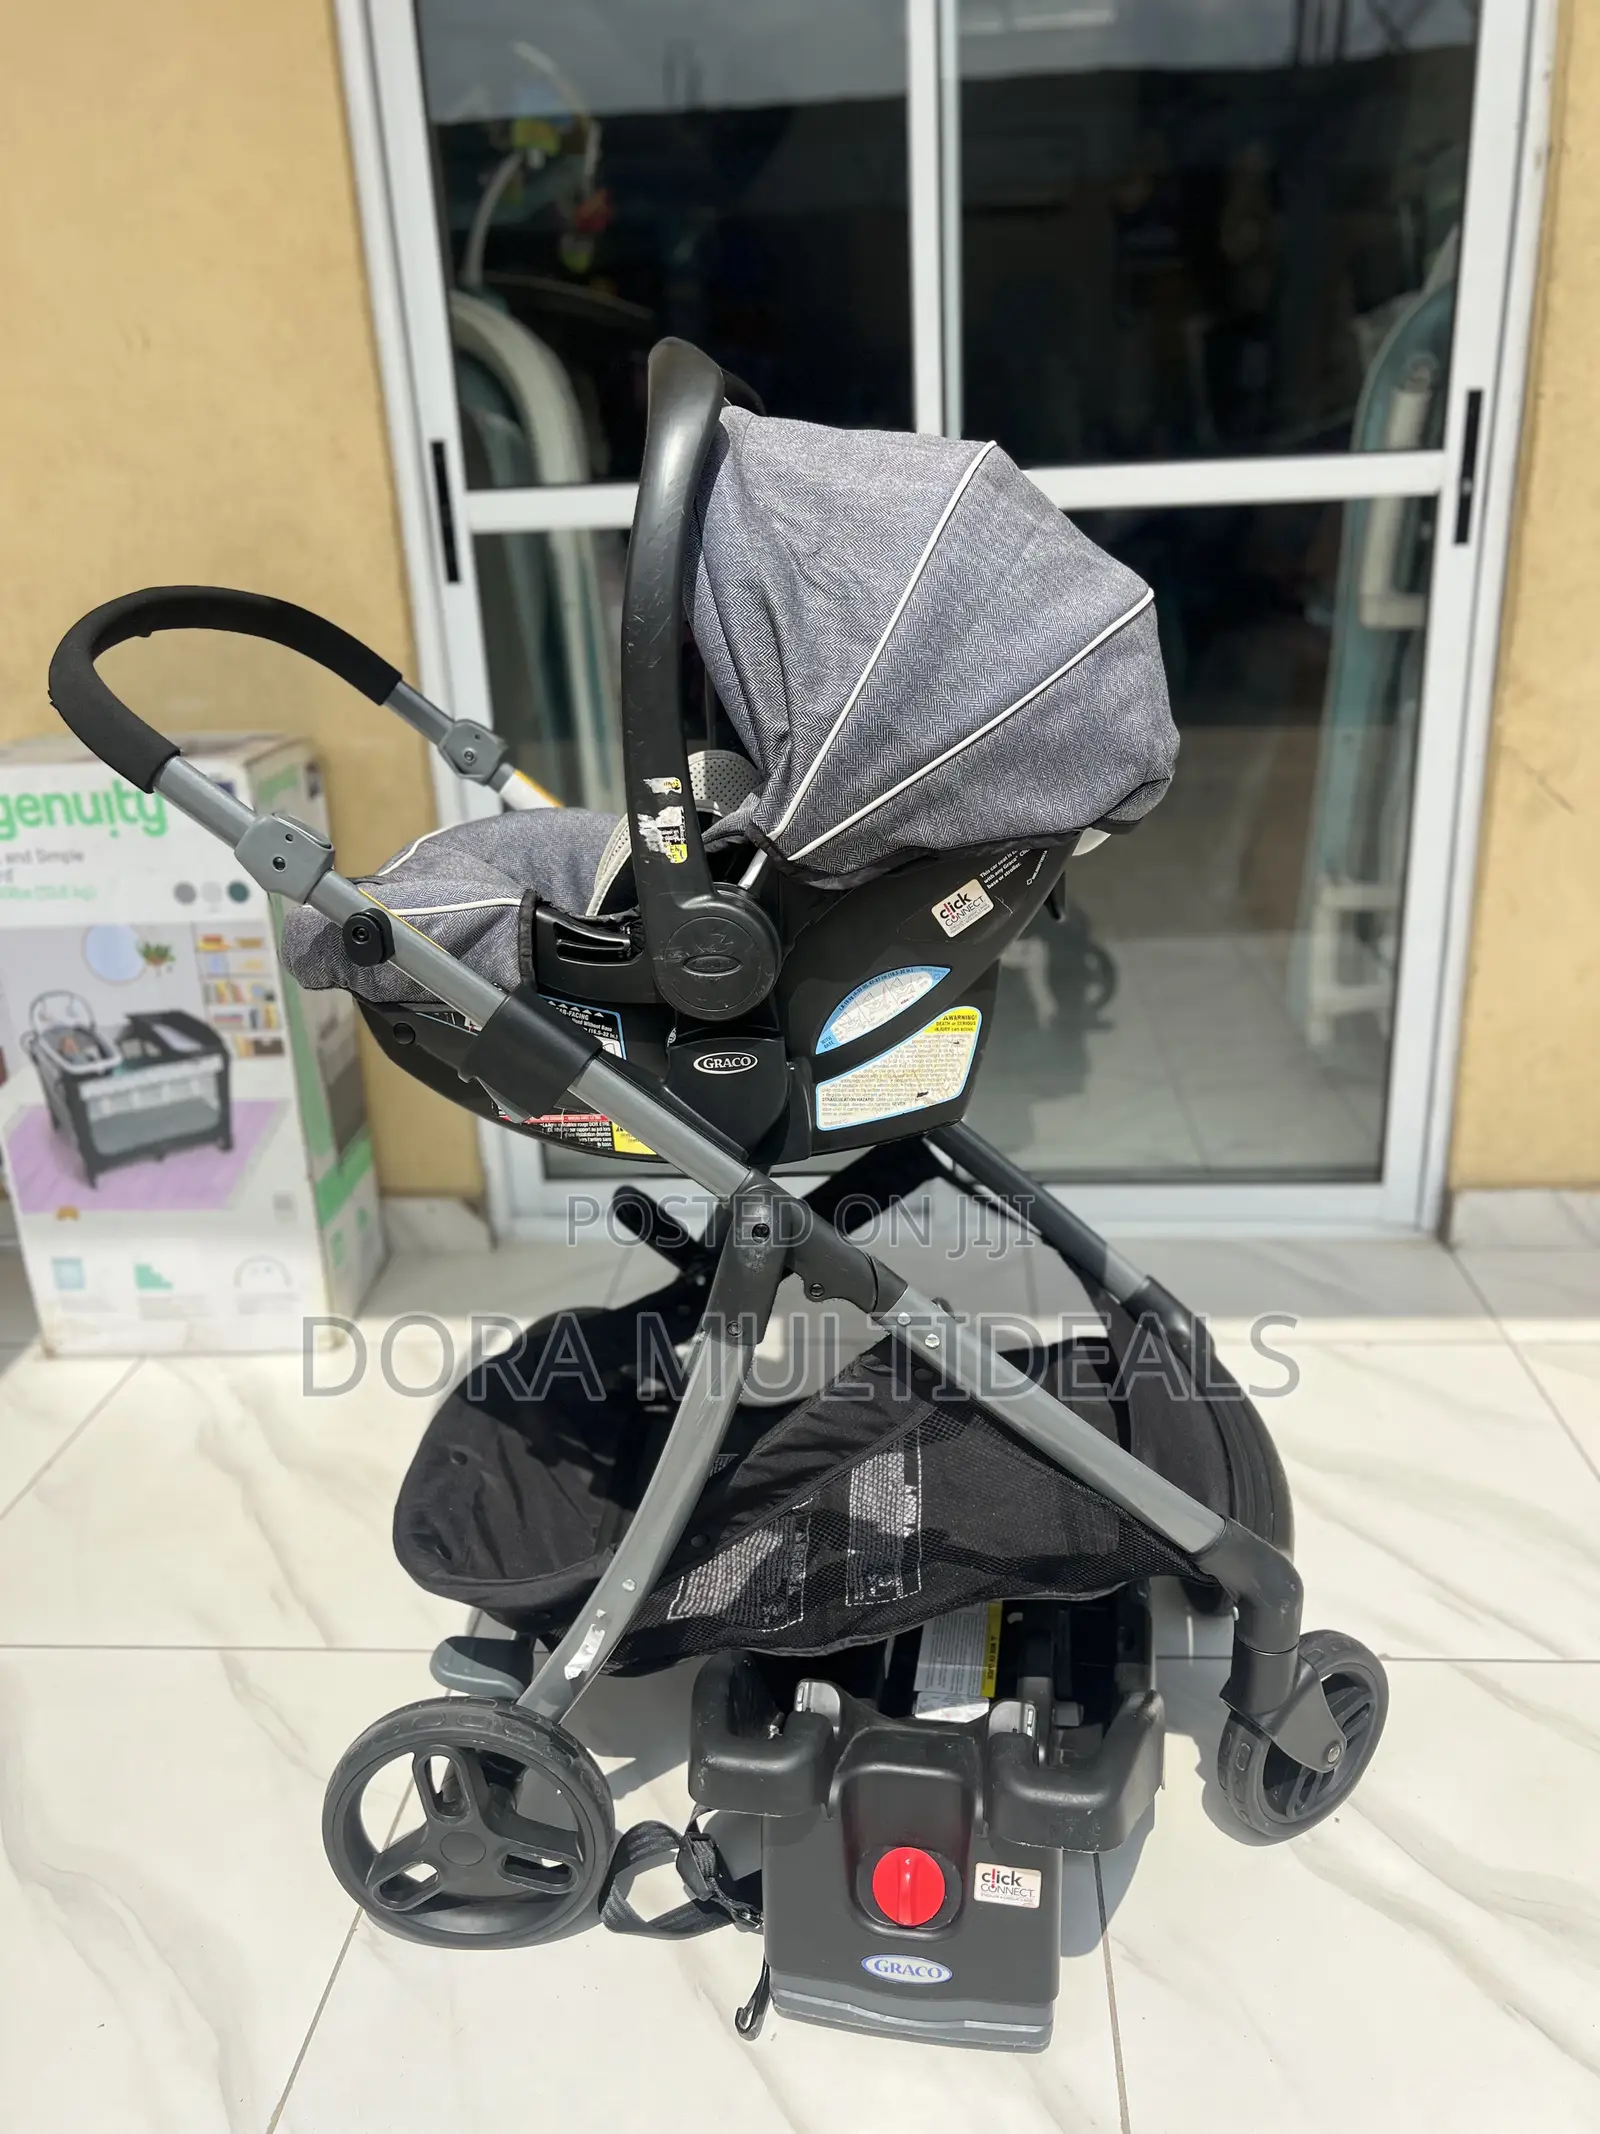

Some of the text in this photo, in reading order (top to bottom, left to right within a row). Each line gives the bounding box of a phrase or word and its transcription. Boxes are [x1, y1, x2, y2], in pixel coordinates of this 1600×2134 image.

[940, 893, 973, 919] click
[945, 895, 984, 927] CONNECT
[703, 1056, 751, 1069] GRACO
[981, 1868, 1022, 1886] click
[874, 1959, 944, 1979] GRACO
